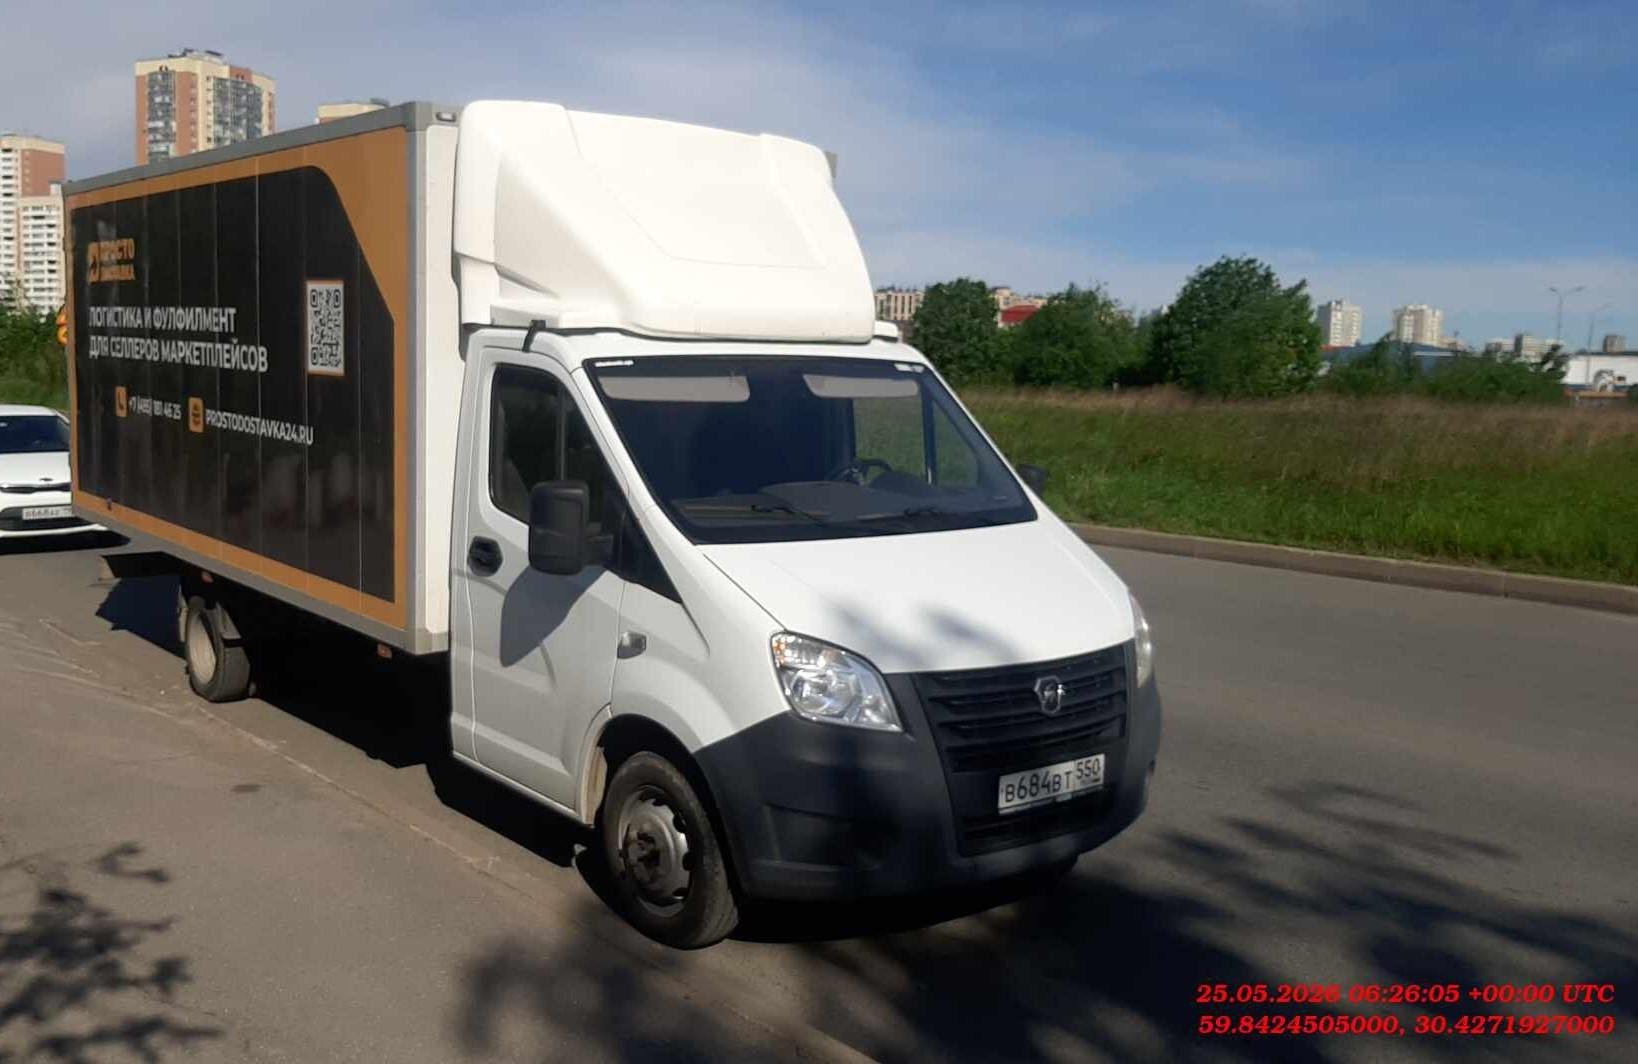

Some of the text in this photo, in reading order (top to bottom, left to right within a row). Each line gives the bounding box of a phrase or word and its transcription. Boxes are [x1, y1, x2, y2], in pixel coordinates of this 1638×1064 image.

[89, 306, 237, 333] ЛОГИСТИКА И ФУЛФИЛМЕНТ
[89, 335, 268, 373] ДЛЯ СЕЛЛЕРОВ МАРКЕТПЛЕЙСОВ
[206, 409, 314, 445] PROSTODOSTAVKA24.RU
[1005, 758, 1100, 803] В684ВТ 550
